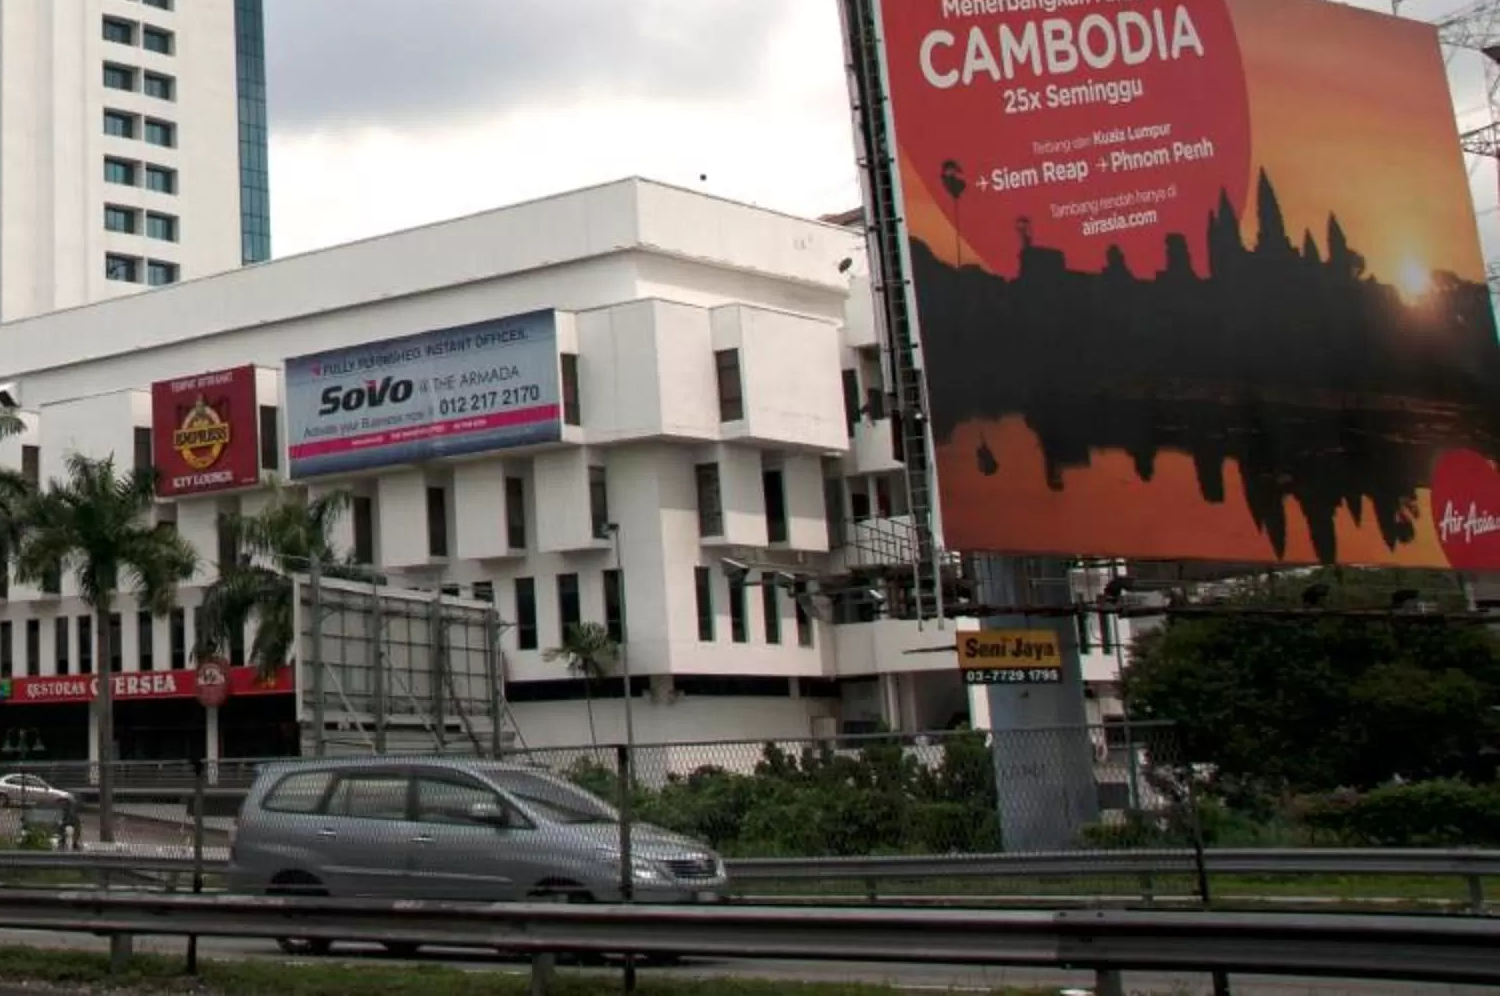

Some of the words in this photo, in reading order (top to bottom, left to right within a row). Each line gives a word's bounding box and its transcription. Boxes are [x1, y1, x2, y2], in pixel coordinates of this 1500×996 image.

[920, 4, 1204, 89] CAMBODIA
[1003, 87, 1042, 113] 25x
[1045, 76, 1144, 106] Seminggu
[1092, 129, 1126, 146] Kuala
[1127, 123, 1172, 141] Lumpur
[991, 166, 1039, 191] Siem
[1042, 159, 1089, 184] Reap
[1110, 147, 1171, 173] Phnom
[1172, 137, 1214, 162] Penh
[1082, 208, 1158, 236] airasia.com
[460, 365, 519, 387] ARMADA
[502, 384, 541, 404] 2170
[965, 636, 1008, 658] Seni
[1011, 636, 1055, 661] Jaya
[90, 673, 177, 697] OERSEA
